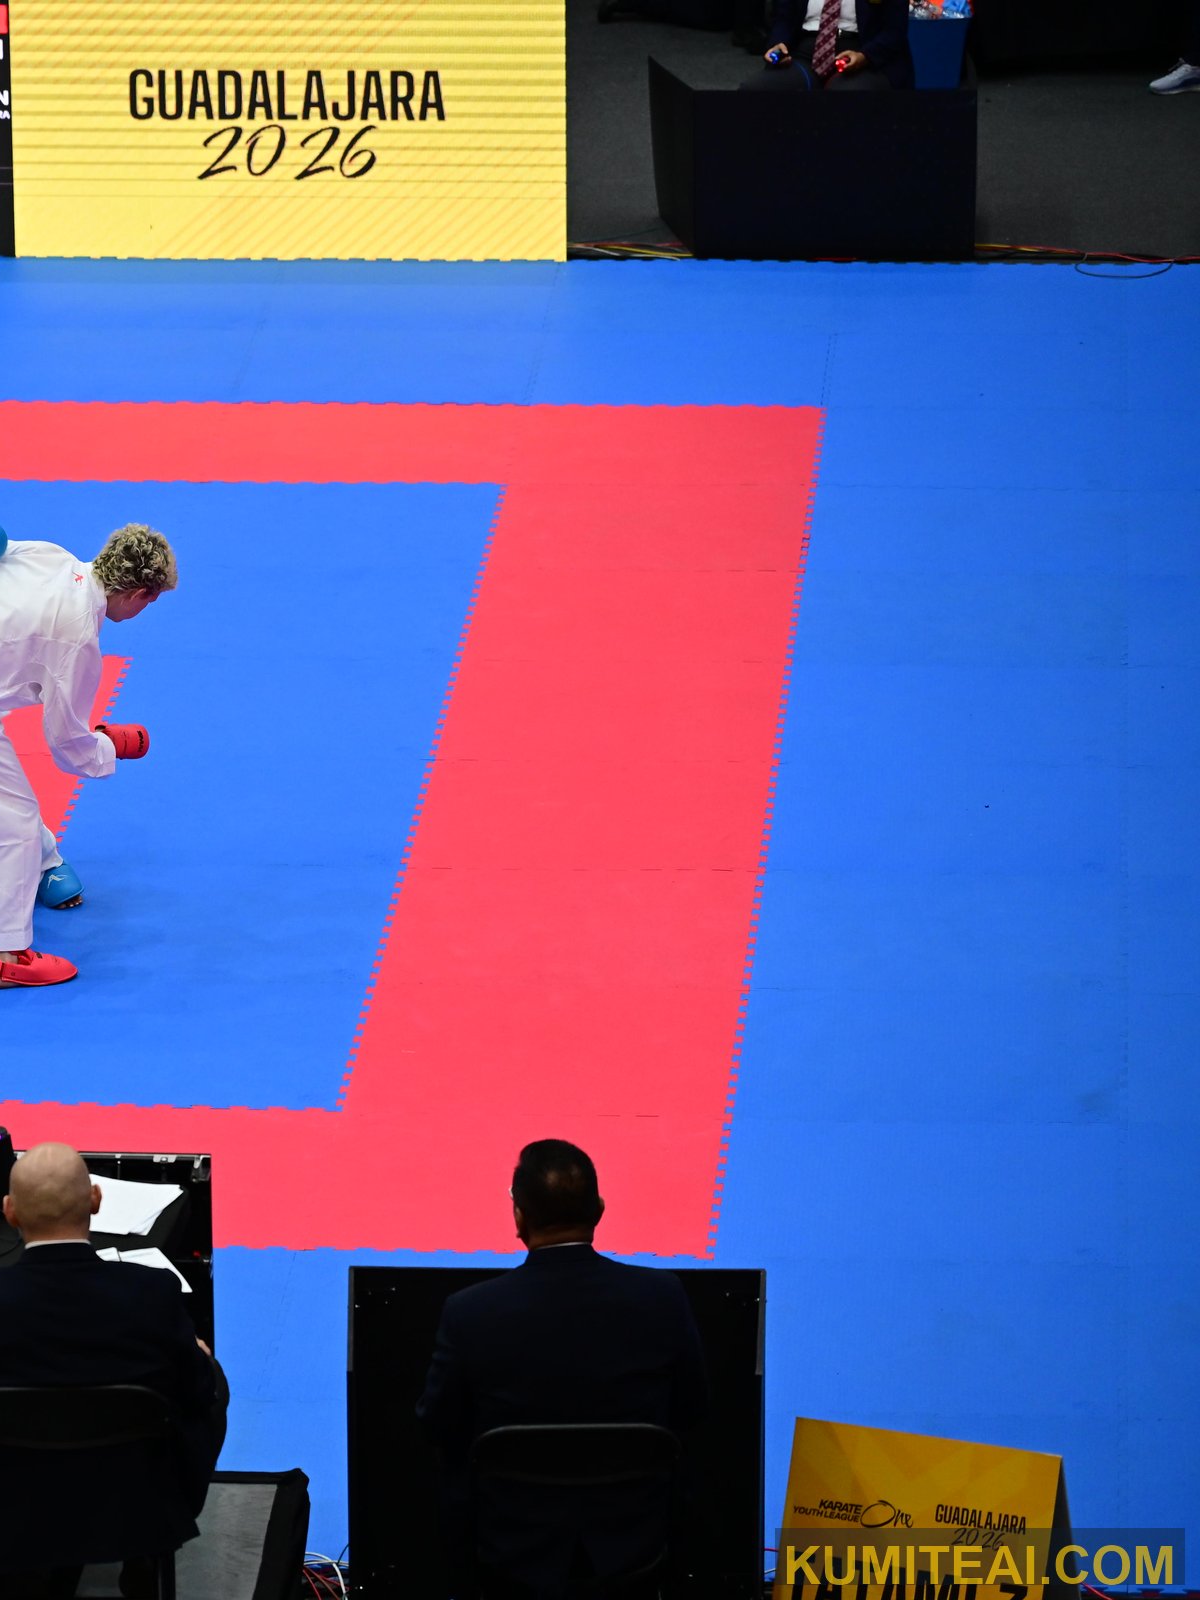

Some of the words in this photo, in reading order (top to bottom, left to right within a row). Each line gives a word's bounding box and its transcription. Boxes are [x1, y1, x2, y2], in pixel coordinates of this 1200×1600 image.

[129, 69, 446, 121] GUADALAJARA
[198, 124, 377, 180] 2026
[793, 1505, 823, 1518] YOUTH
[823, 1510, 861, 1523] LEAGUE
[819, 1499, 863, 1515] KARATE
[861, 1500, 914, 1529] One
[934, 1504, 1027, 1535] GUADALAJARA
[951, 1527, 1006, 1551] 2026
